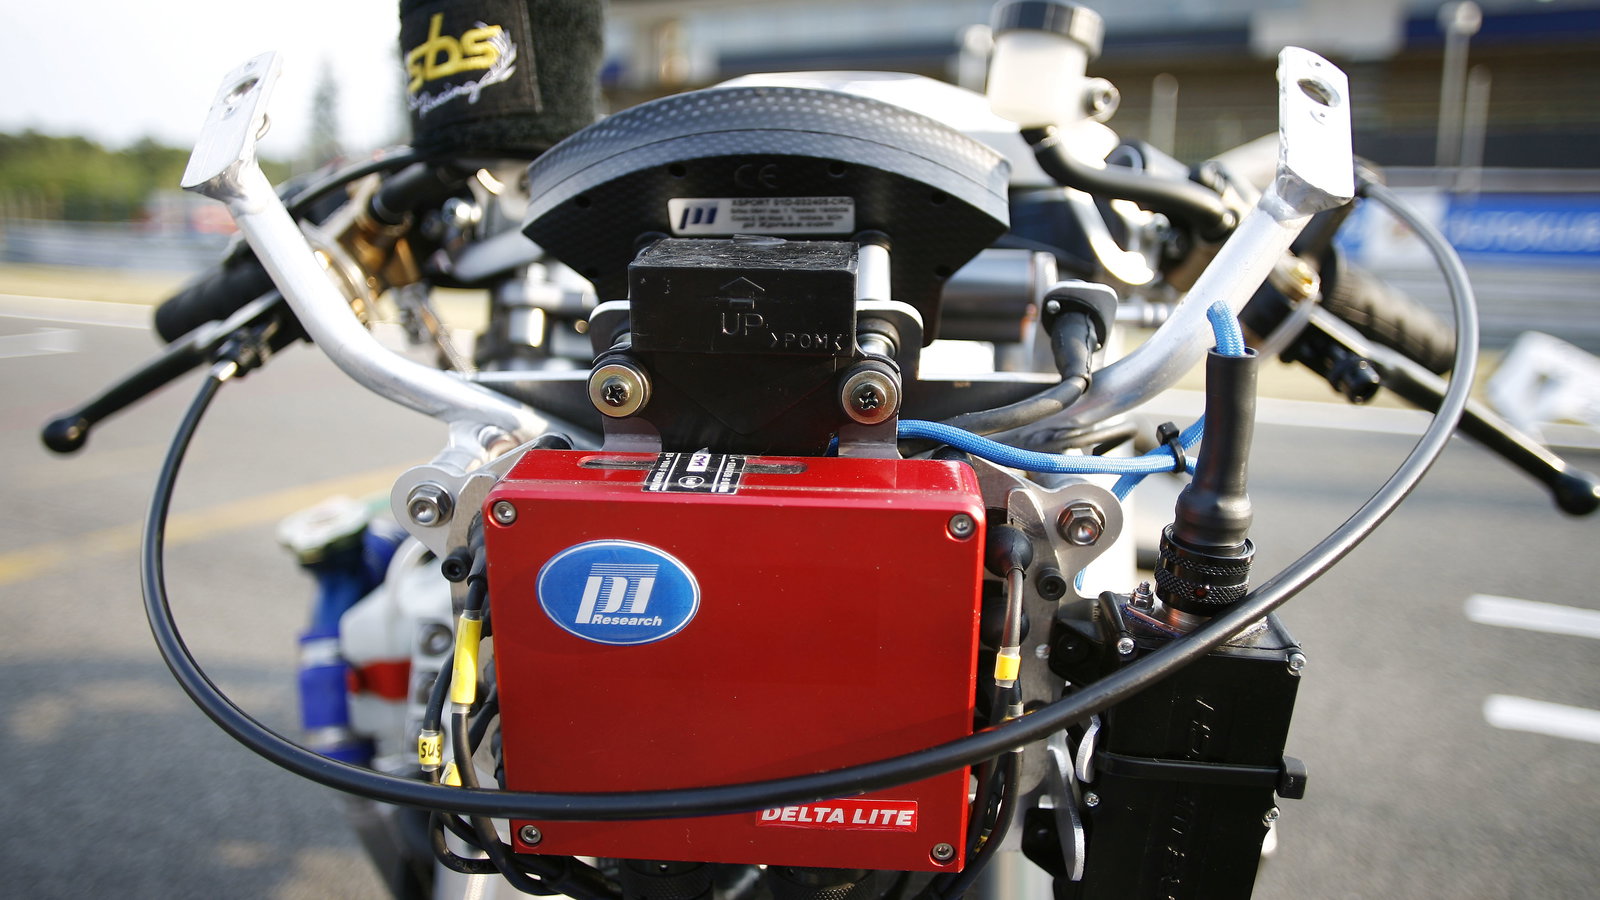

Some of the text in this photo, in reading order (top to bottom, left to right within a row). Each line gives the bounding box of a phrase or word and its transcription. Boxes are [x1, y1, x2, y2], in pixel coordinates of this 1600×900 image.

[408, 13, 501, 93] sbs
[734, 163, 780, 190] CE
[721, 312, 764, 336] UP
[591, 613, 663, 626] Research
[760, 806, 915, 826] DELTA LITE
